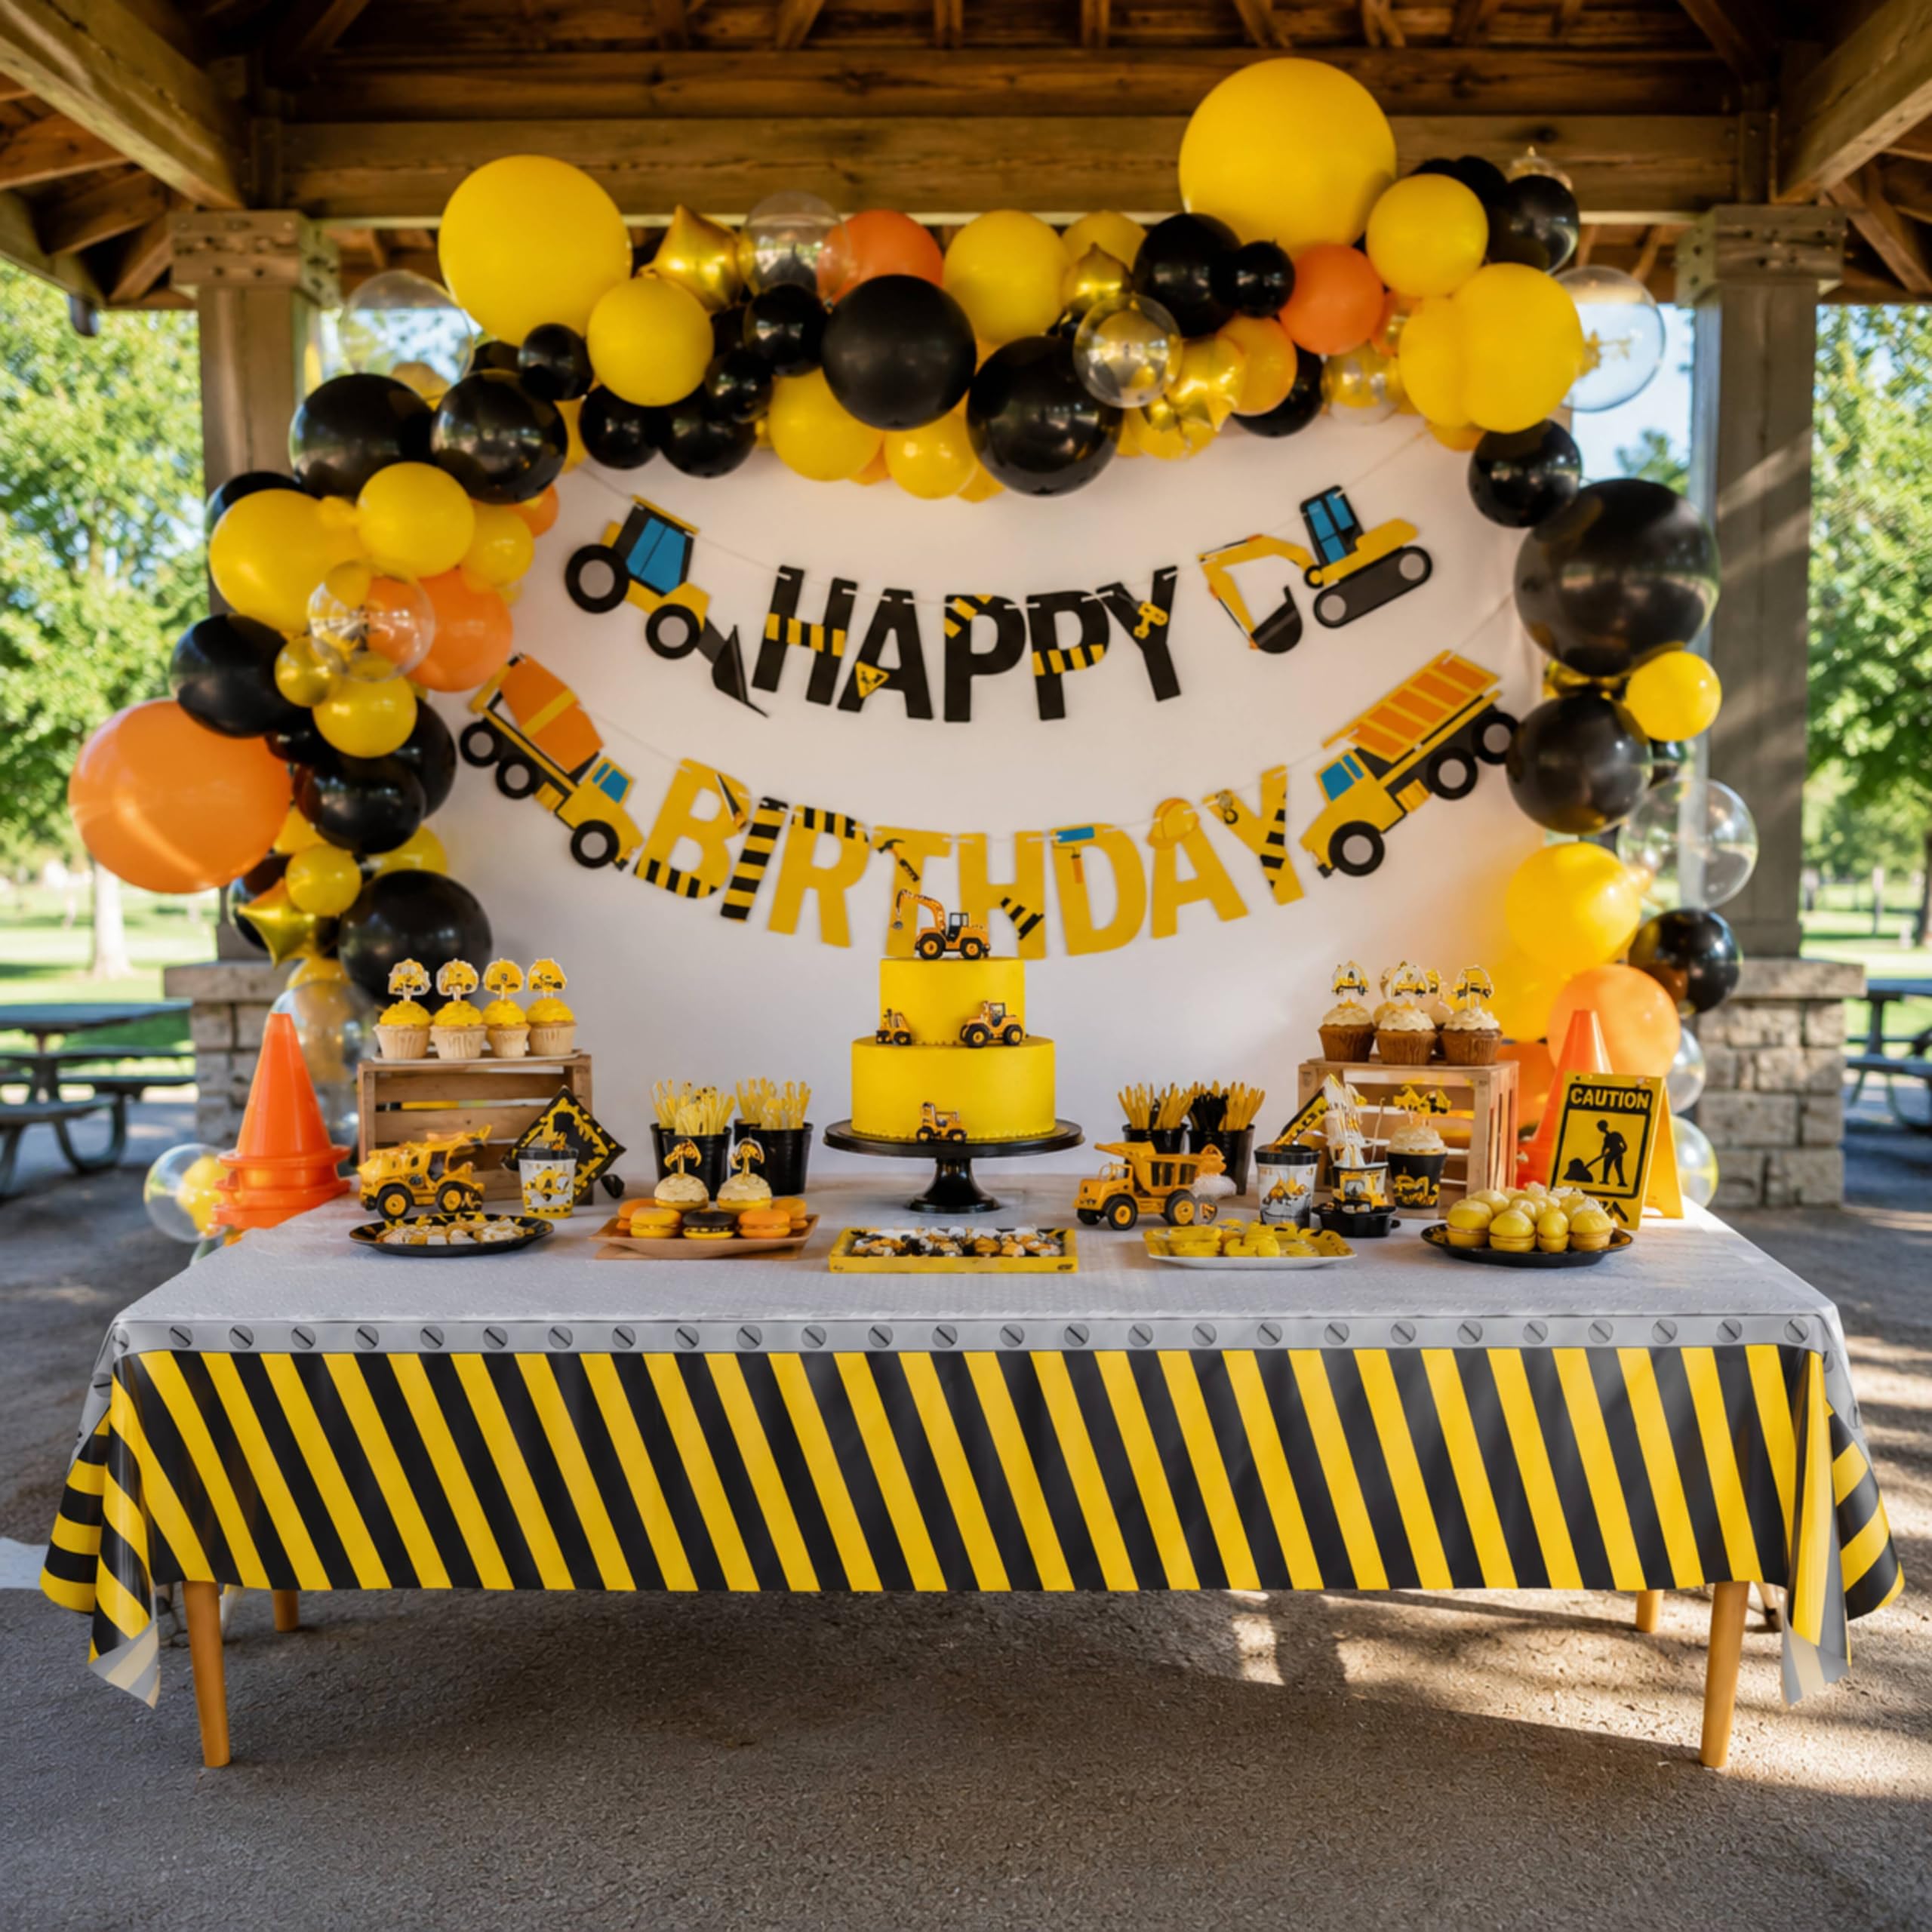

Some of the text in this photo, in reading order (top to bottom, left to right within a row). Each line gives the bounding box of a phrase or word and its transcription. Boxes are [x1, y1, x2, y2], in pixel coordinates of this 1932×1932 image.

[752, 565, 1180, 722] HAPPY
[632, 758, 1304, 960] BIRTHDAY
[1571, 1088, 1650, 1109] CAUTION
